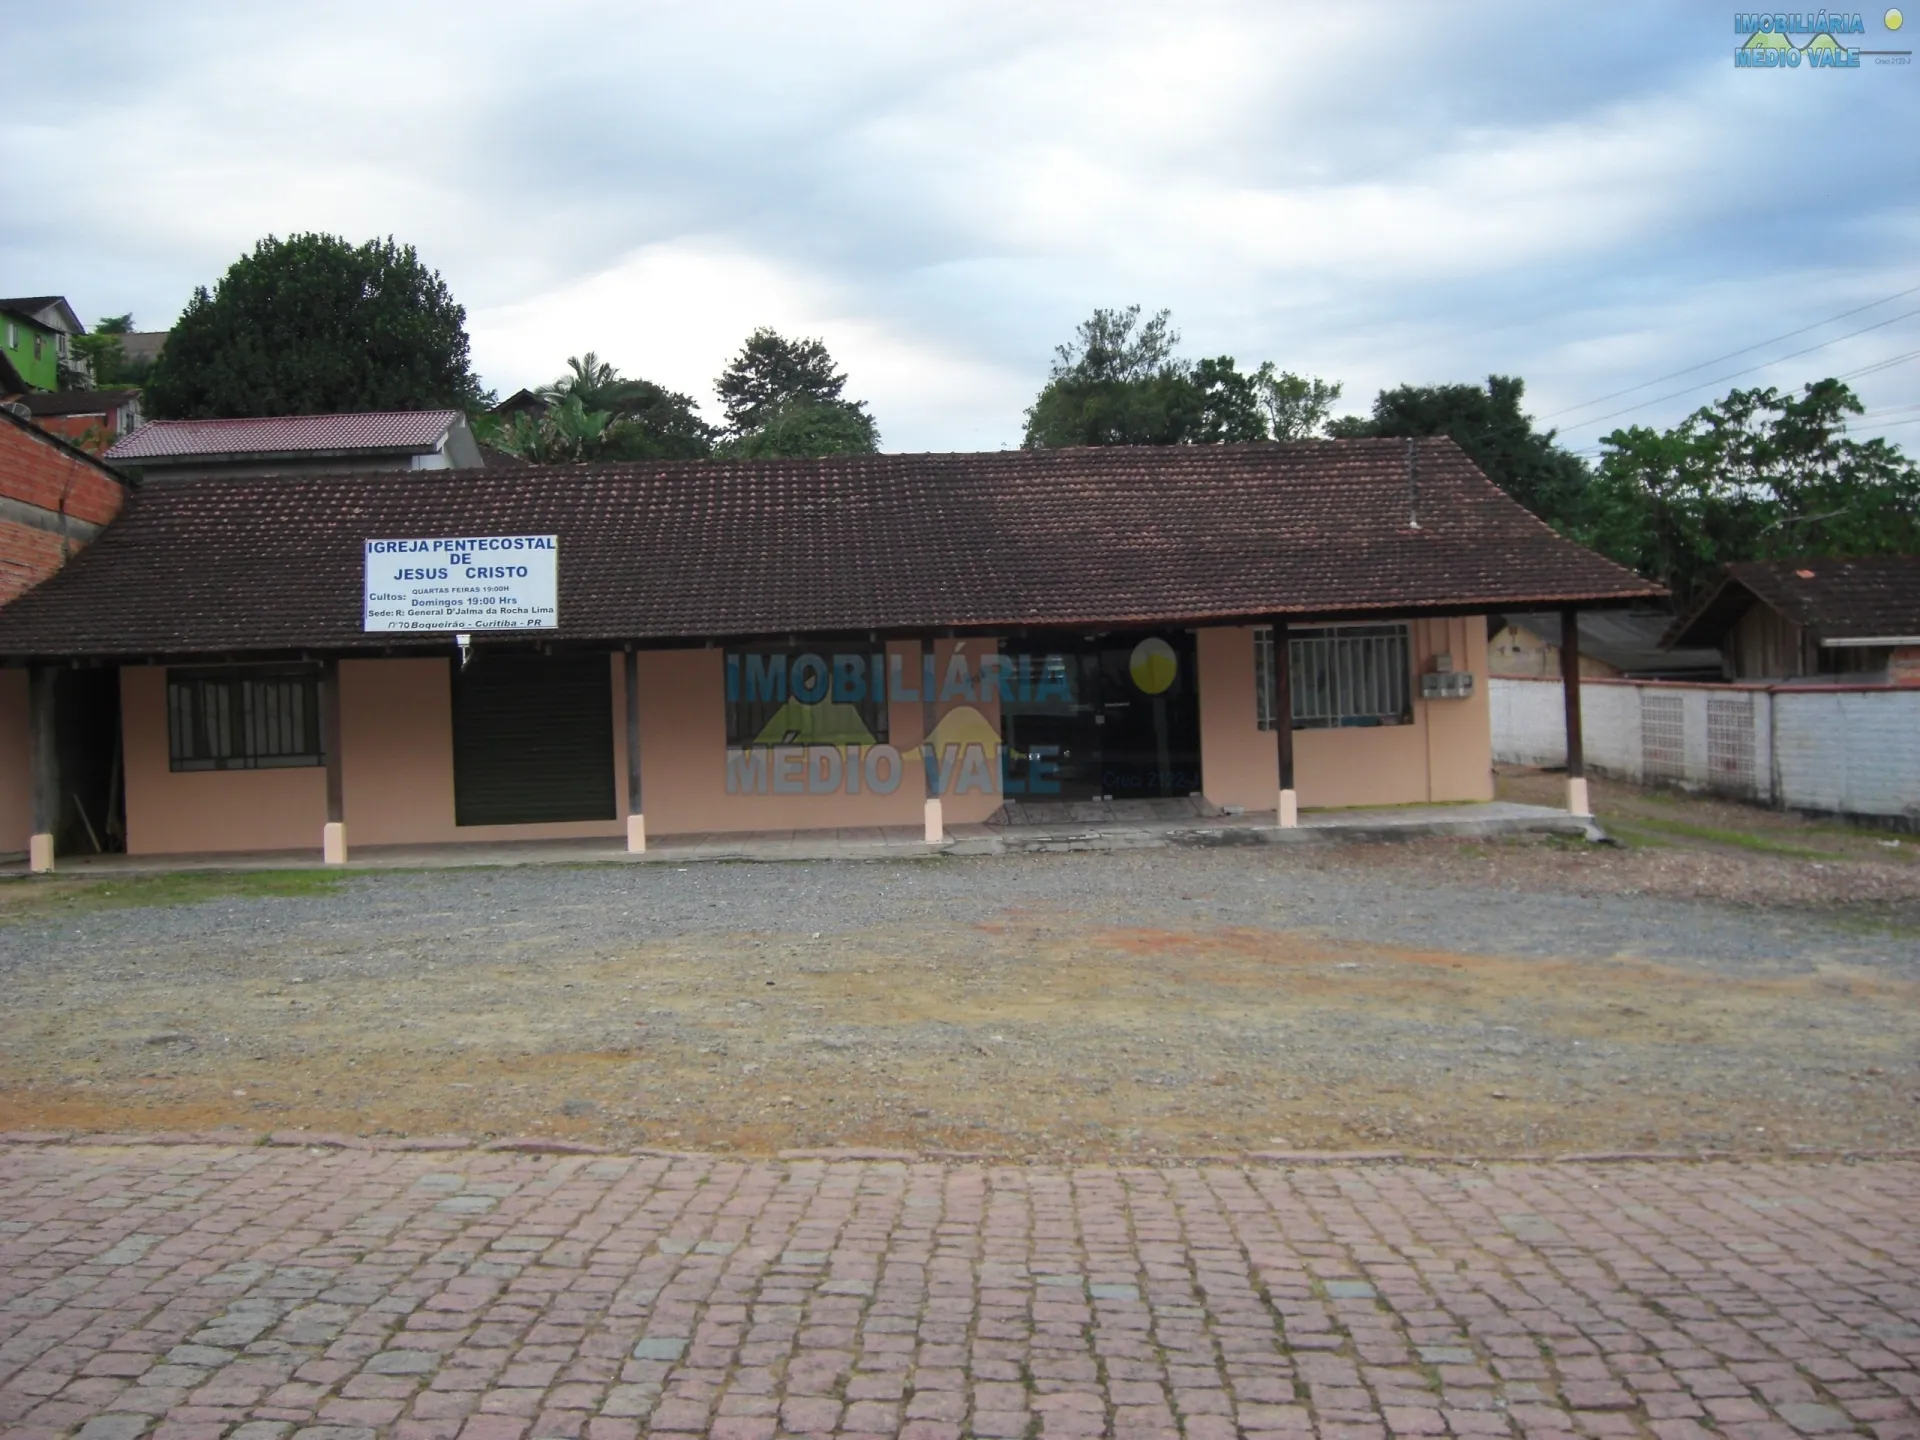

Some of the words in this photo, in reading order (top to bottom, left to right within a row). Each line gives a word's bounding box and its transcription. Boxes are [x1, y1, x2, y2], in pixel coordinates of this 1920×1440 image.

[368, 541, 429, 553] IGREJA
[433, 538, 556, 552] PENTECOSTAL
[450, 553, 472, 565] DE
[394, 568, 448, 580] JESUS
[465, 566, 528, 579] CRISTO
[369, 593, 406, 601] Cultos:
[411, 598, 463, 607] Domingos
[467, 597, 495, 605] 19:00
[408, 608, 443, 616] General
[411, 621, 465, 630] Boqueirão
[475, 620, 517, 628] Curitiba
